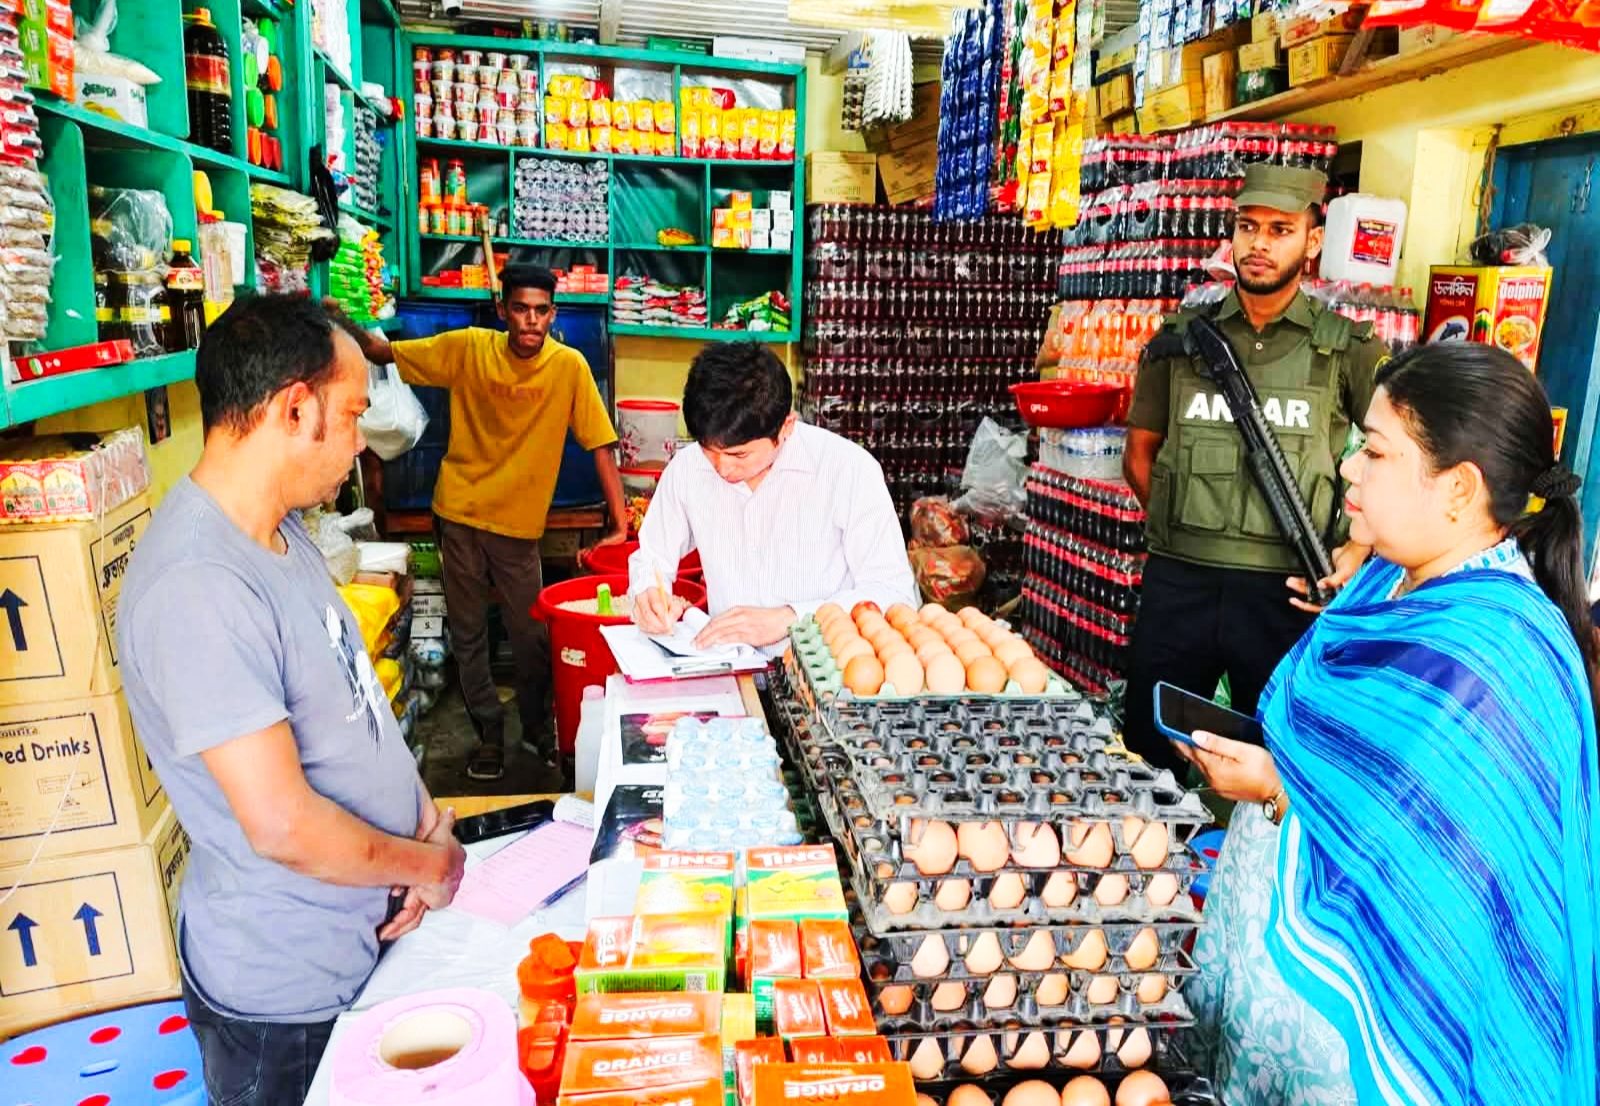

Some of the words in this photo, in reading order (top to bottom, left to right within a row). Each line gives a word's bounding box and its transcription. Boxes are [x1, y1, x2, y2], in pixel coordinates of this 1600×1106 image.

[1434, 276, 1475, 297] ডলফিন
[1500, 281, 1544, 300] Dolphin
[1184, 392, 1310, 428] ANAR
[31, 736, 91, 761] Drinks
[599, 1006, 693, 1024] ORANGE
[593, 1051, 693, 1072] ORANGE
[784, 1079, 885, 1099] ORANGE
